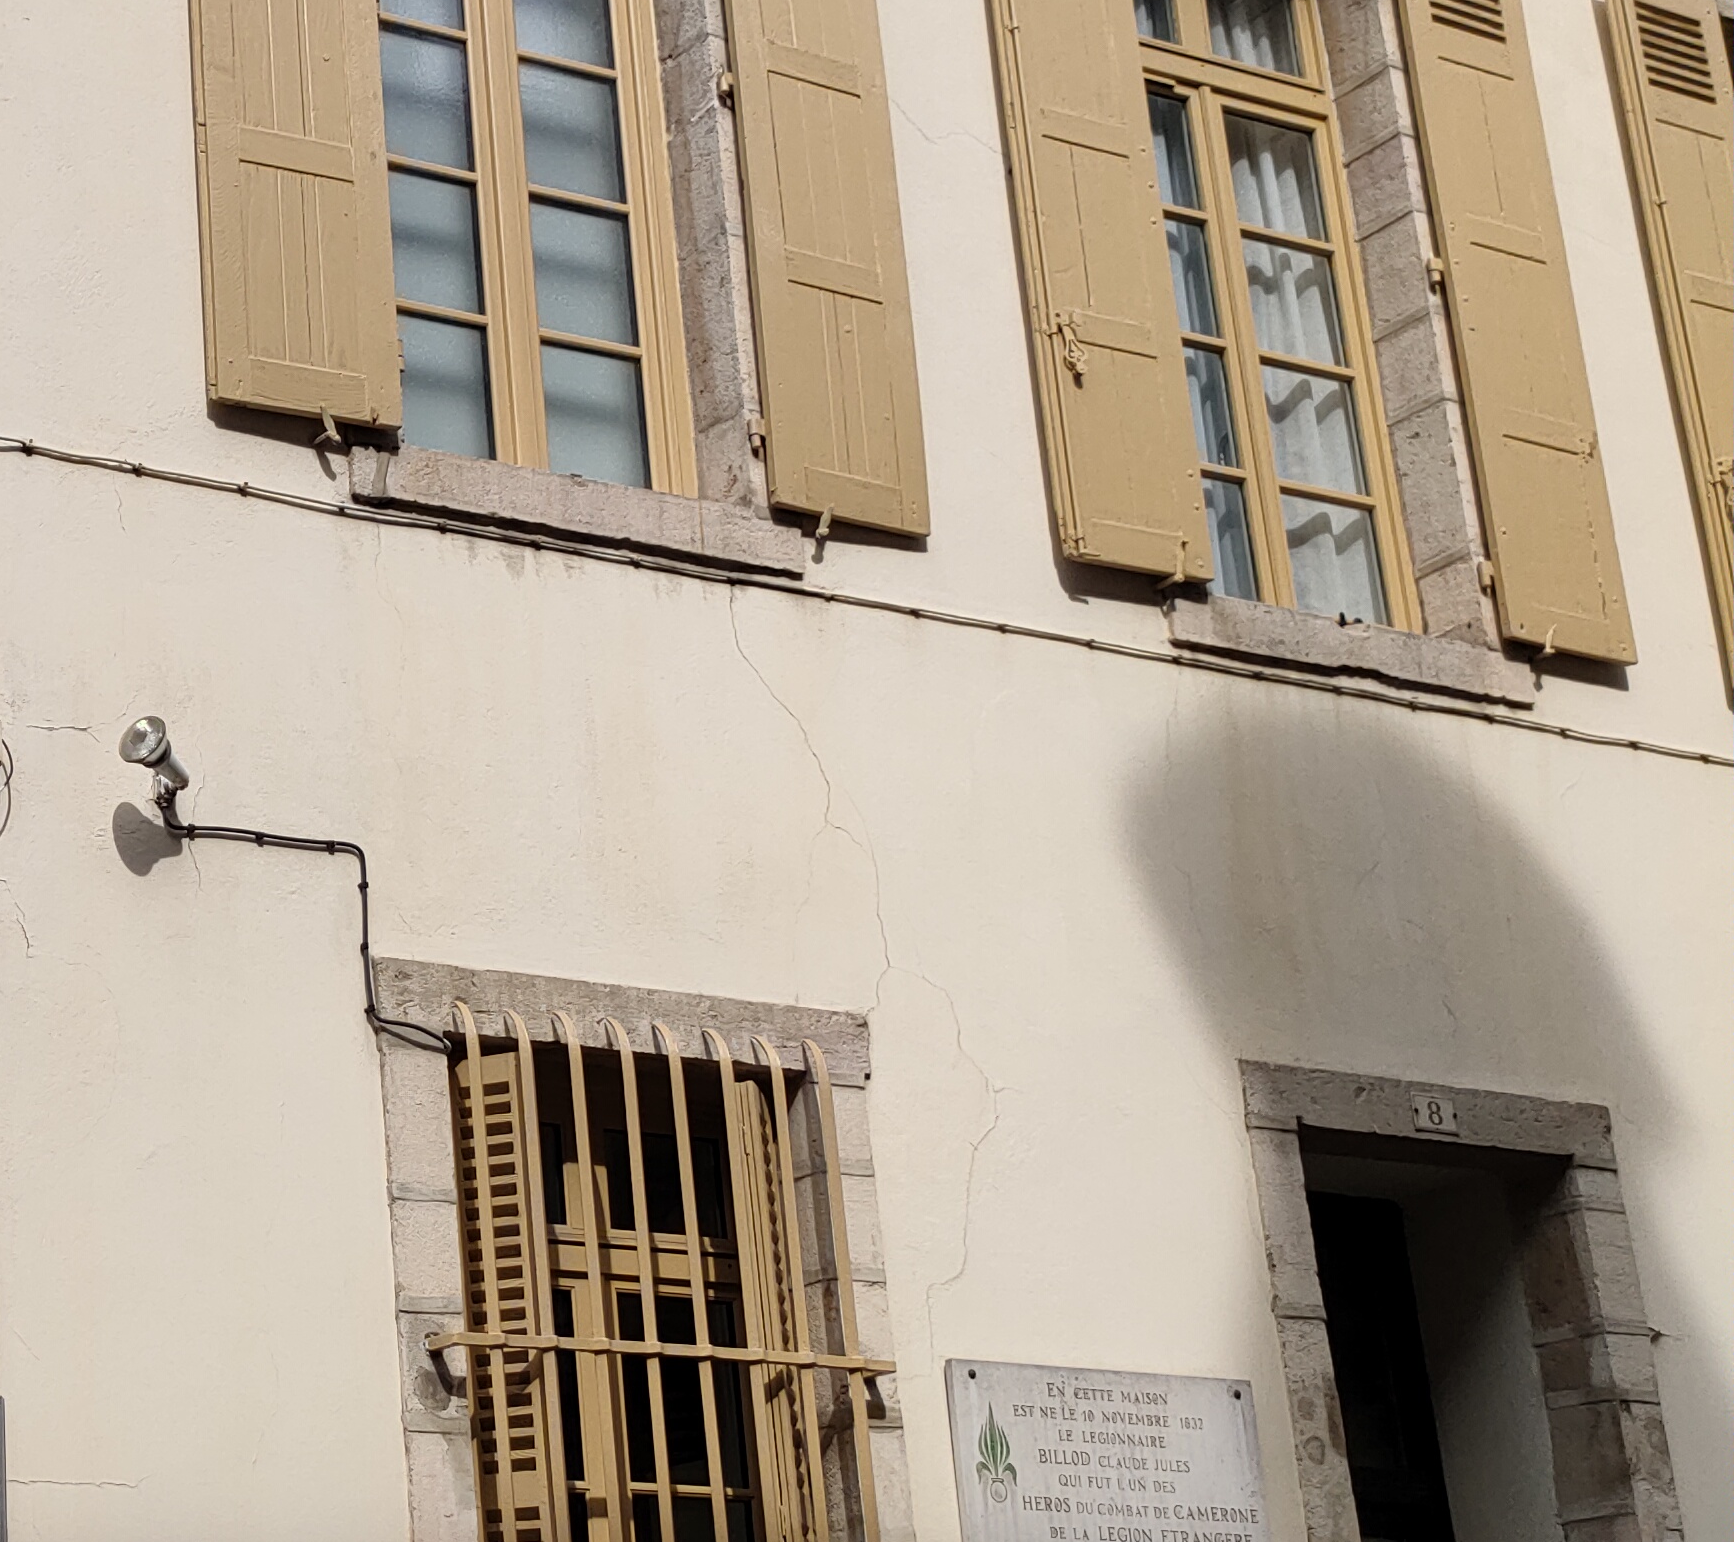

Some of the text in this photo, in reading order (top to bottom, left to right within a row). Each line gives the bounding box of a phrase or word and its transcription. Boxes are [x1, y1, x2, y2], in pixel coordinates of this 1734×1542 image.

[1427, 1101, 1443, 1126] 8
[1046, 1382, 1168, 1406] EN CETTE MAISON
[1012, 1404, 1035, 1418] EST
[1062, 1406, 1077, 1422] LE
[1081, 1409, 1095, 1423] 10
[1101, 1410, 1170, 1428] NOVEMBRE
[1058, 1428, 1166, 1449] LE LEGIONNAIRE
[1037, 1448, 1191, 1474] BILLOD CLAUDE JULES
[1058, 1473, 1082, 1488] QUI
[1087, 1476, 1112, 1490] FUT
[1152, 1479, 1176, 1493] DES
[1022, 1495, 1260, 1525] HEROS DU COMBAT DE CAMERONE
[1049, 1526, 1067, 1540] DE
[1073, 1527, 1090, 1541] LA
